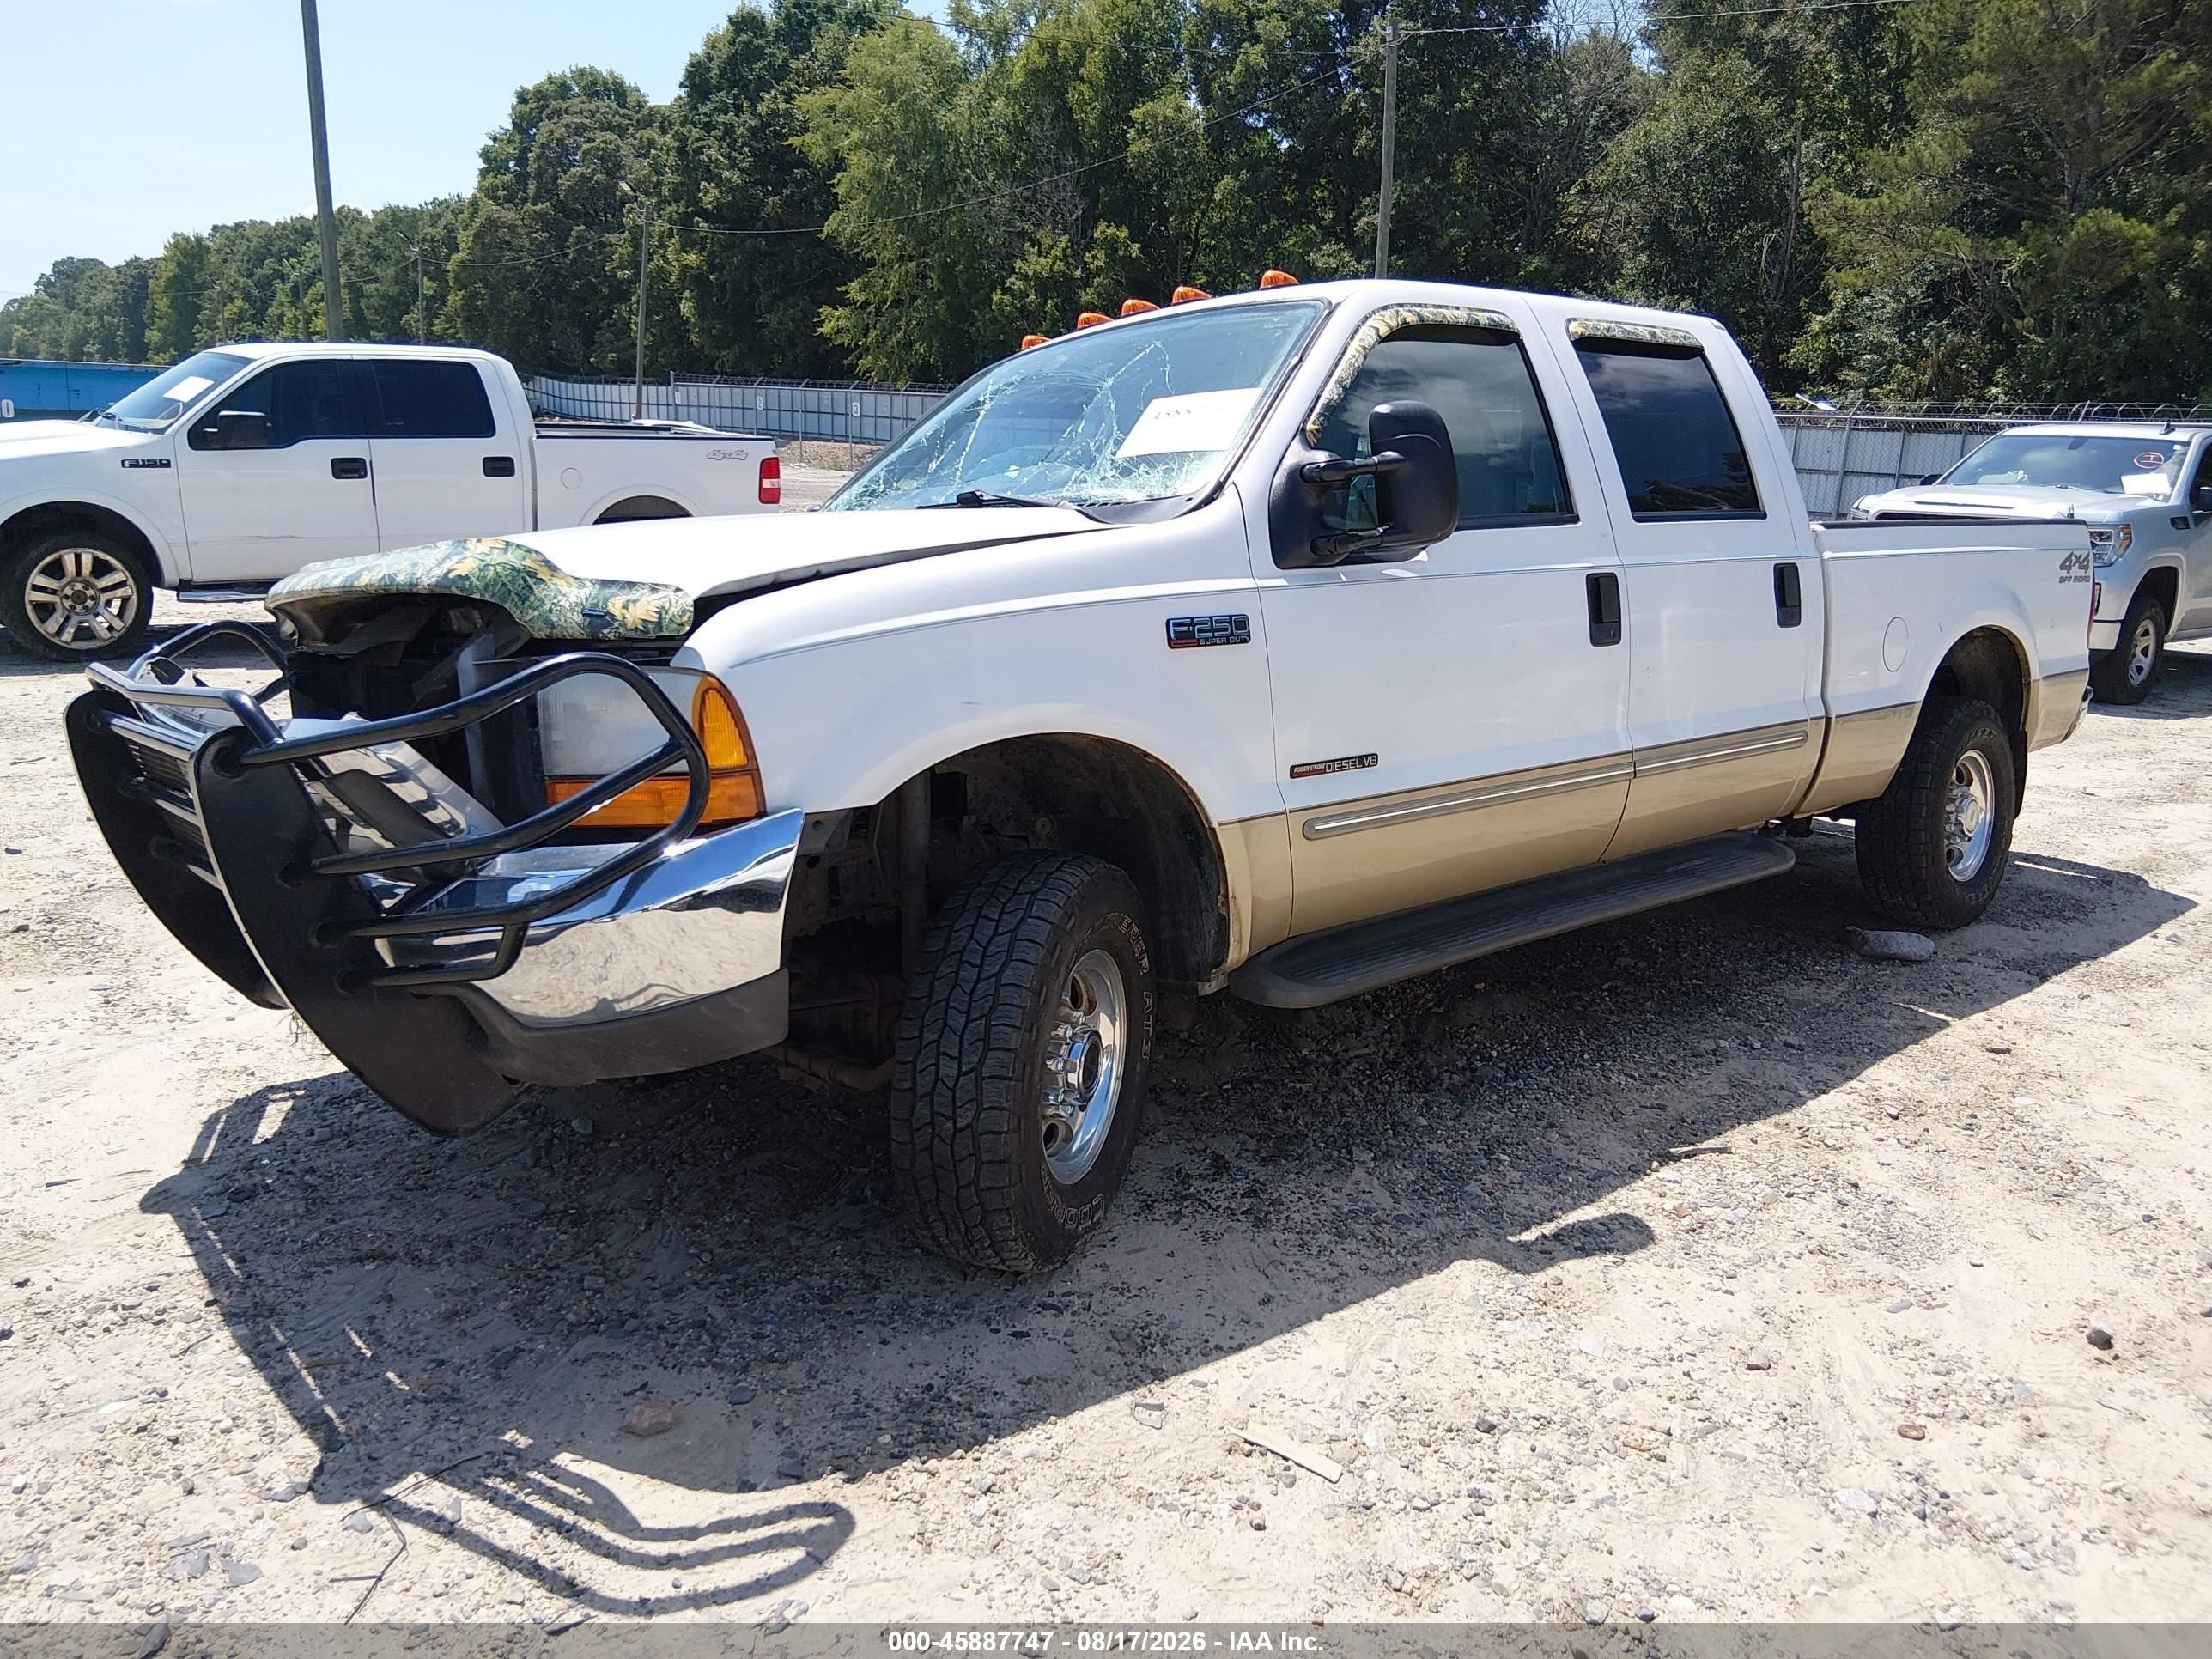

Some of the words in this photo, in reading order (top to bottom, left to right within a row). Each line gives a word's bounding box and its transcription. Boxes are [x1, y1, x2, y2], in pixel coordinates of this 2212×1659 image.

[706, 449, 750, 461] 4x4
[2059, 550, 2090, 574] 4x4
[1169, 616, 1250, 640] F-250
[1325, 758, 1363, 773] DIESEL
[1364, 755, 1377, 766] V8
[1141, 991, 1153, 1060] AT3
